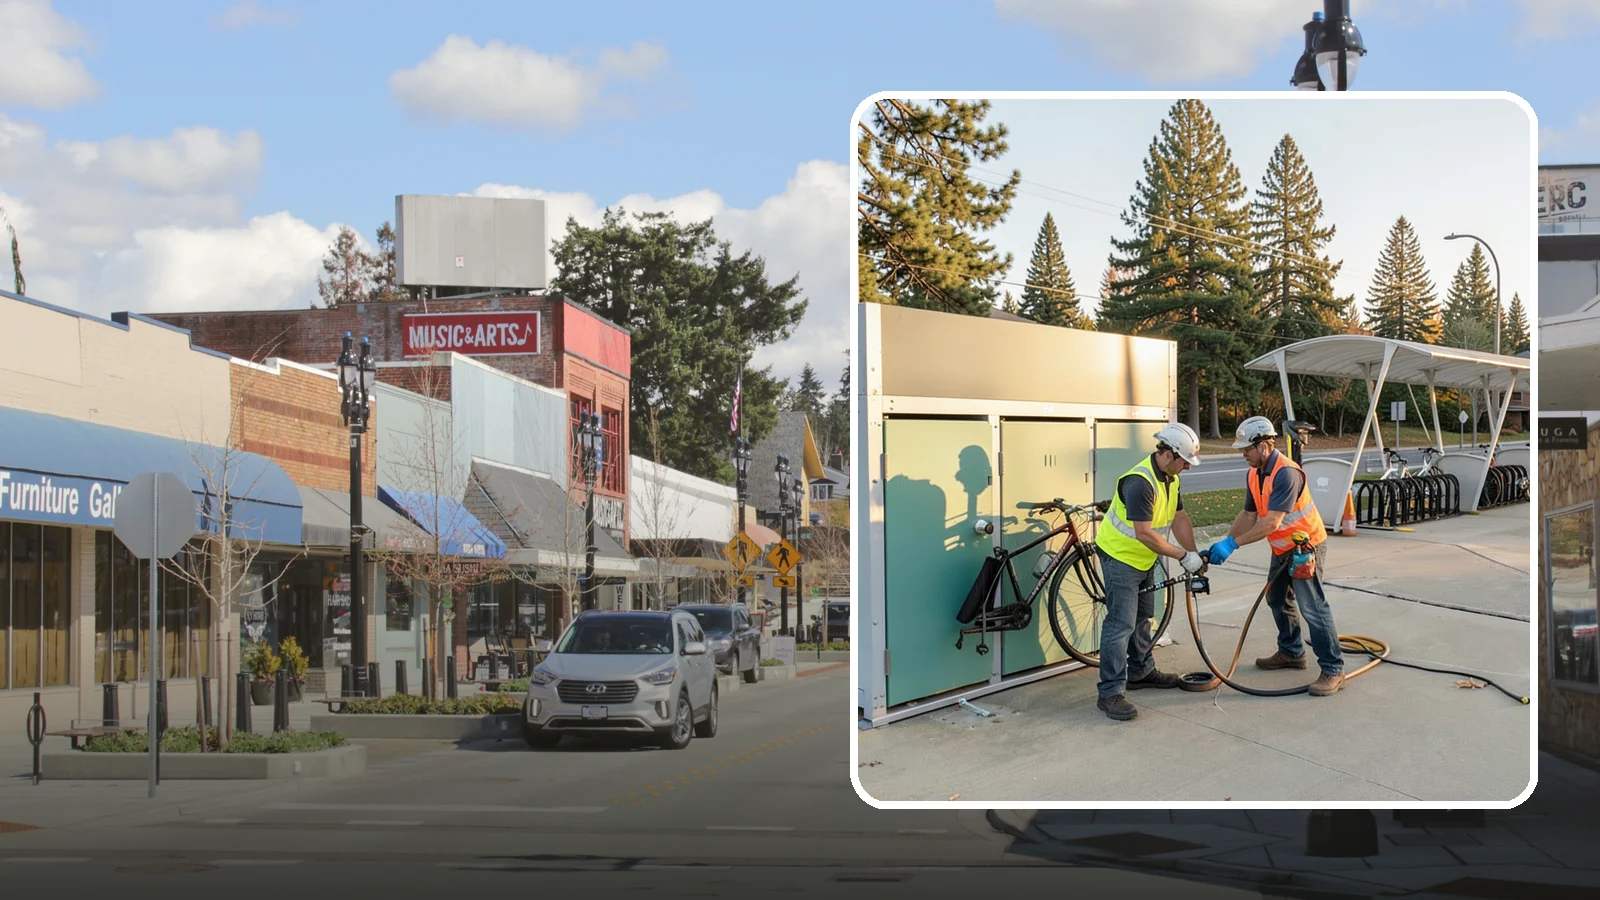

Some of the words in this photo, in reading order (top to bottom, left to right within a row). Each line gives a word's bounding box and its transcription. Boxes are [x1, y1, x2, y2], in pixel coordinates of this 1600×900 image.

[409, 323, 519, 349] MUSIC&ARTS
[1540, 427, 1577, 437] UGA
[0, 471, 79, 515] Furniture
[453, 563, 480, 575] SUSHI
